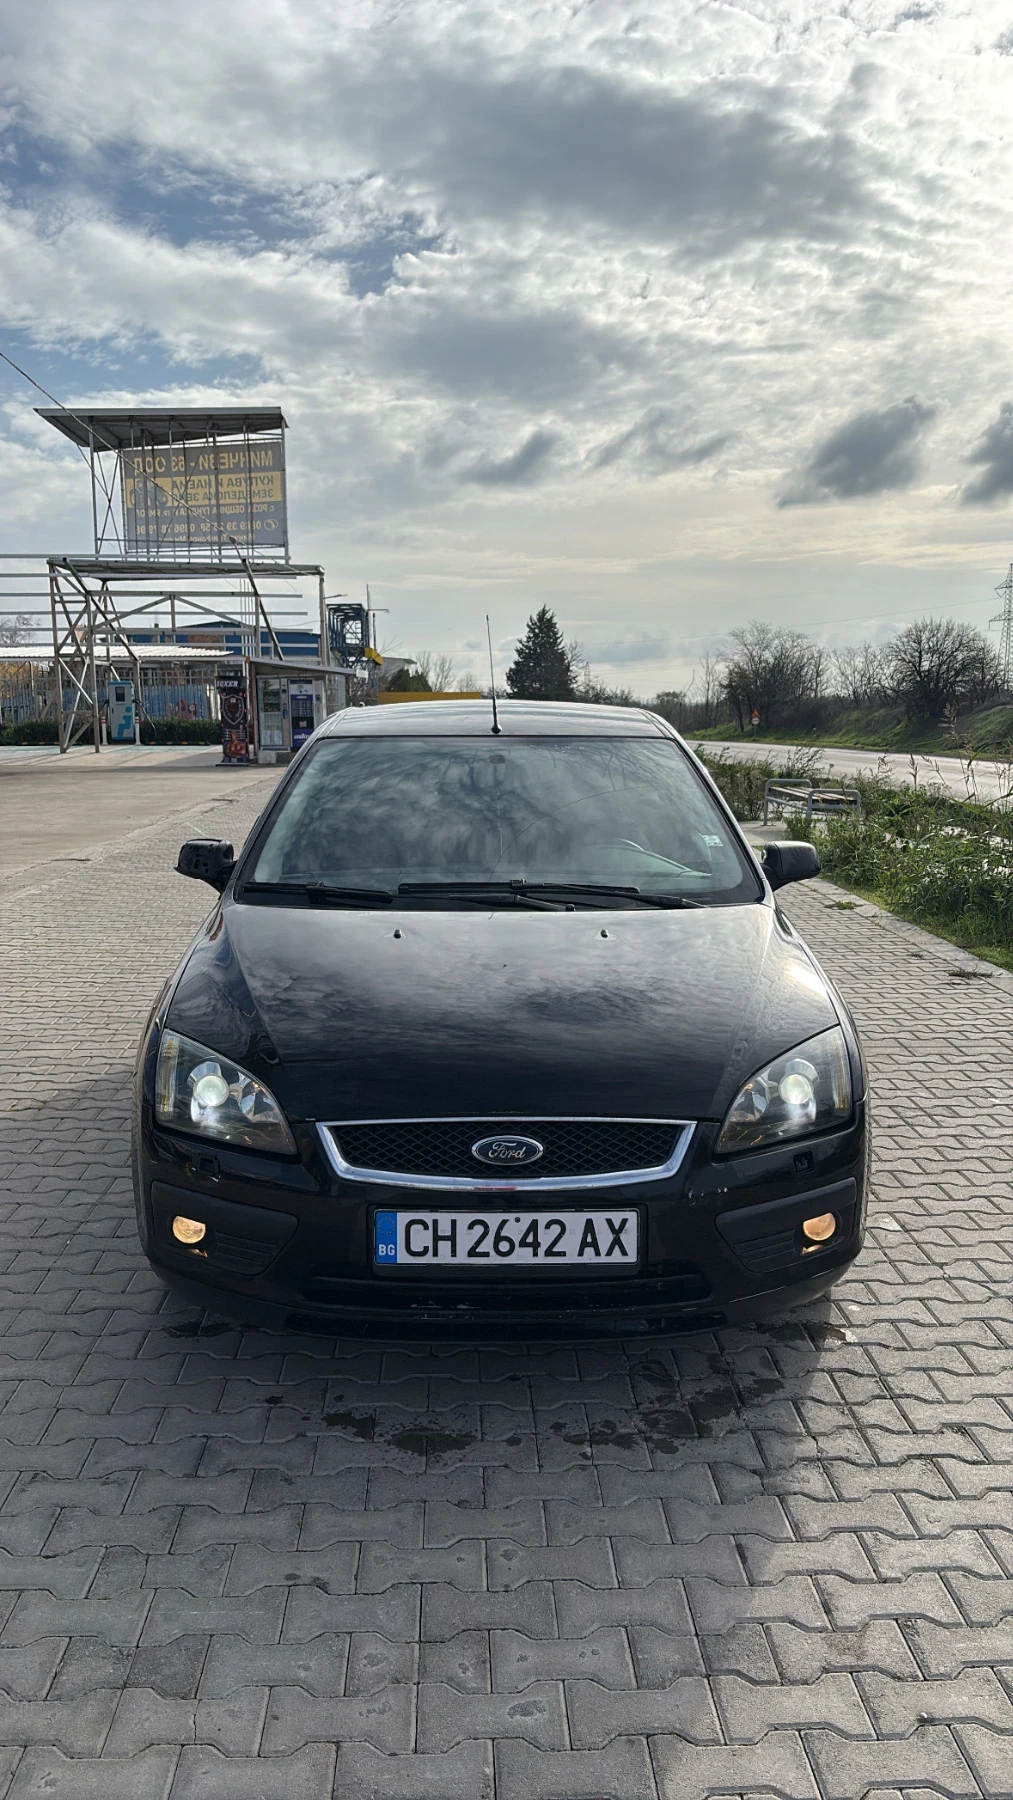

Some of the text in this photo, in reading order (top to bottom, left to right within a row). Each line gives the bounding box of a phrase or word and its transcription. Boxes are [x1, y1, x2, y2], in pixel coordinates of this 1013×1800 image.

[488, 1141, 527, 1160] Ford
[404, 1218, 629, 1258] CH 2642 AX
[378, 1243, 395, 1256] BG
